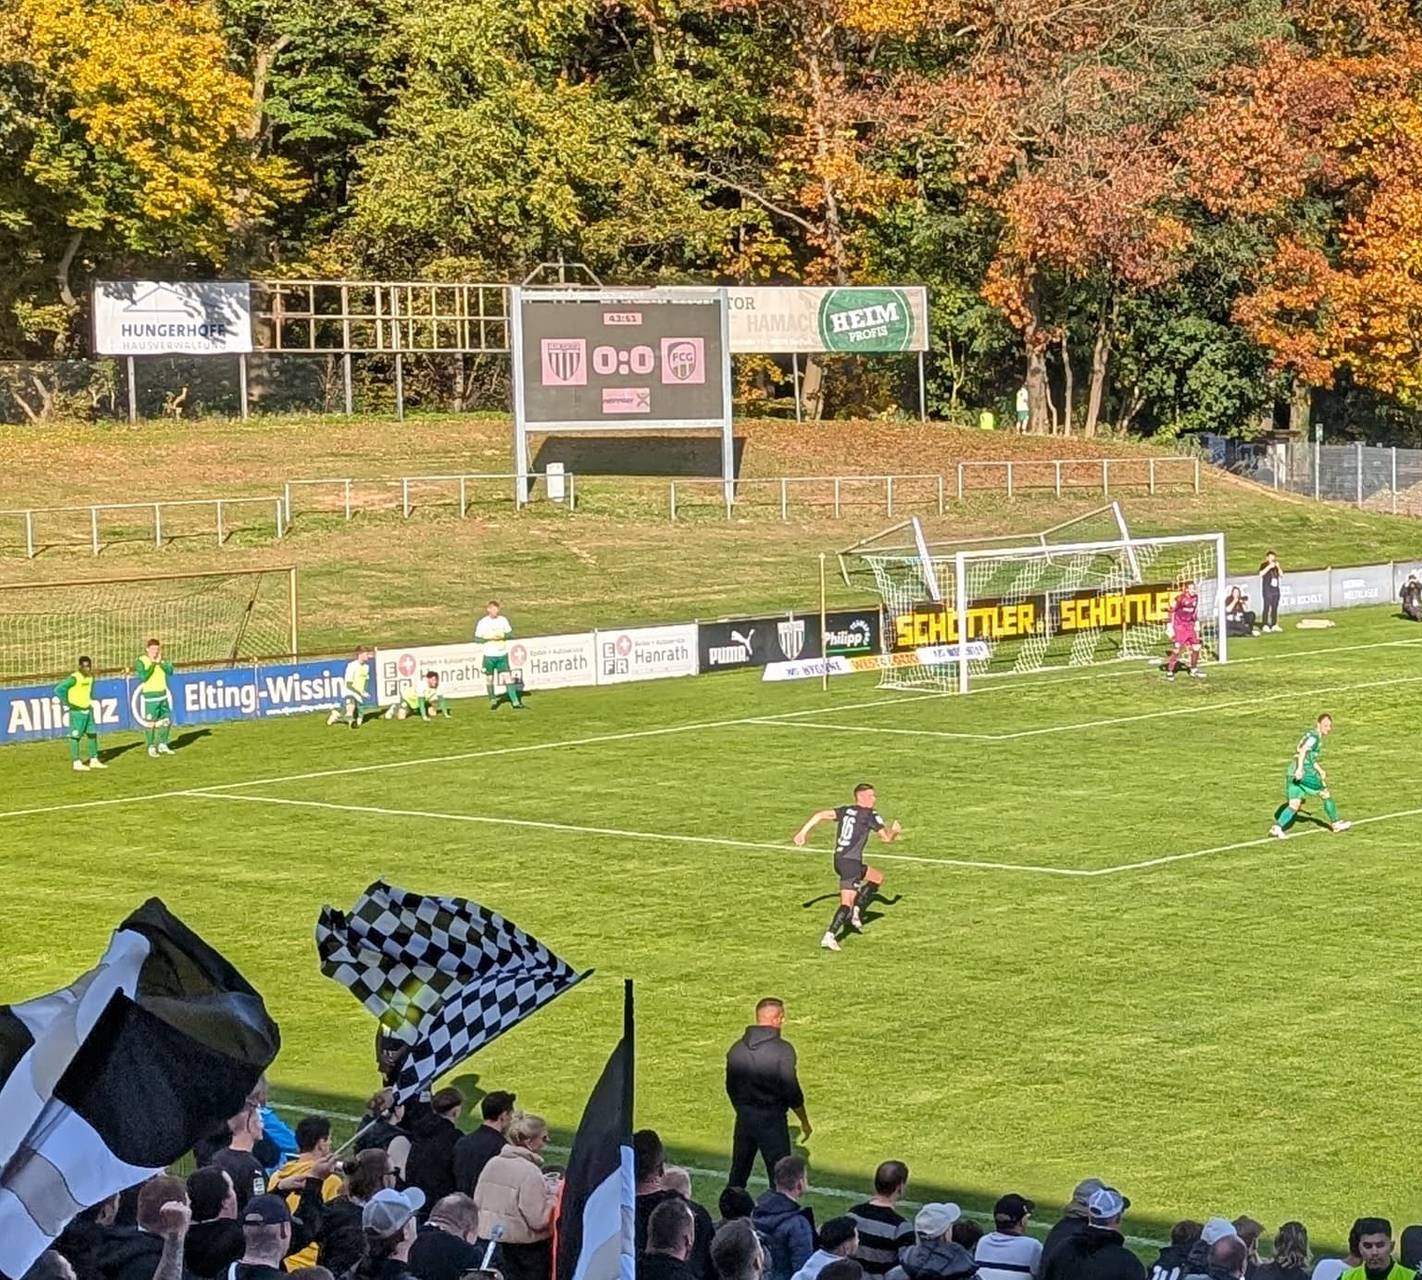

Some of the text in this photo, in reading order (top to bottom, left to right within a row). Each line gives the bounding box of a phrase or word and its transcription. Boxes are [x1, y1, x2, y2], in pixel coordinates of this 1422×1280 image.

[830, 302, 900, 333] HEIM
[121, 323, 226, 338] HUNGERHOFF
[848, 326, 889, 343] PROFIS
[122, 341, 226, 350] HAUSVERWALTUNG
[592, 345, 656, 375] 0:0
[672, 352, 694, 362] FCG
[896, 604, 1035, 647] SCHÖTTLER
[824, 630, 863, 648] Philipp
[635, 644, 689, 665] Hanrath
[420, 664, 480, 684] Hnrath
[530, 655, 588, 675] Hanrath
[184, 670, 348, 714] Elting-Wissin
[841, 816, 857, 840] 16
